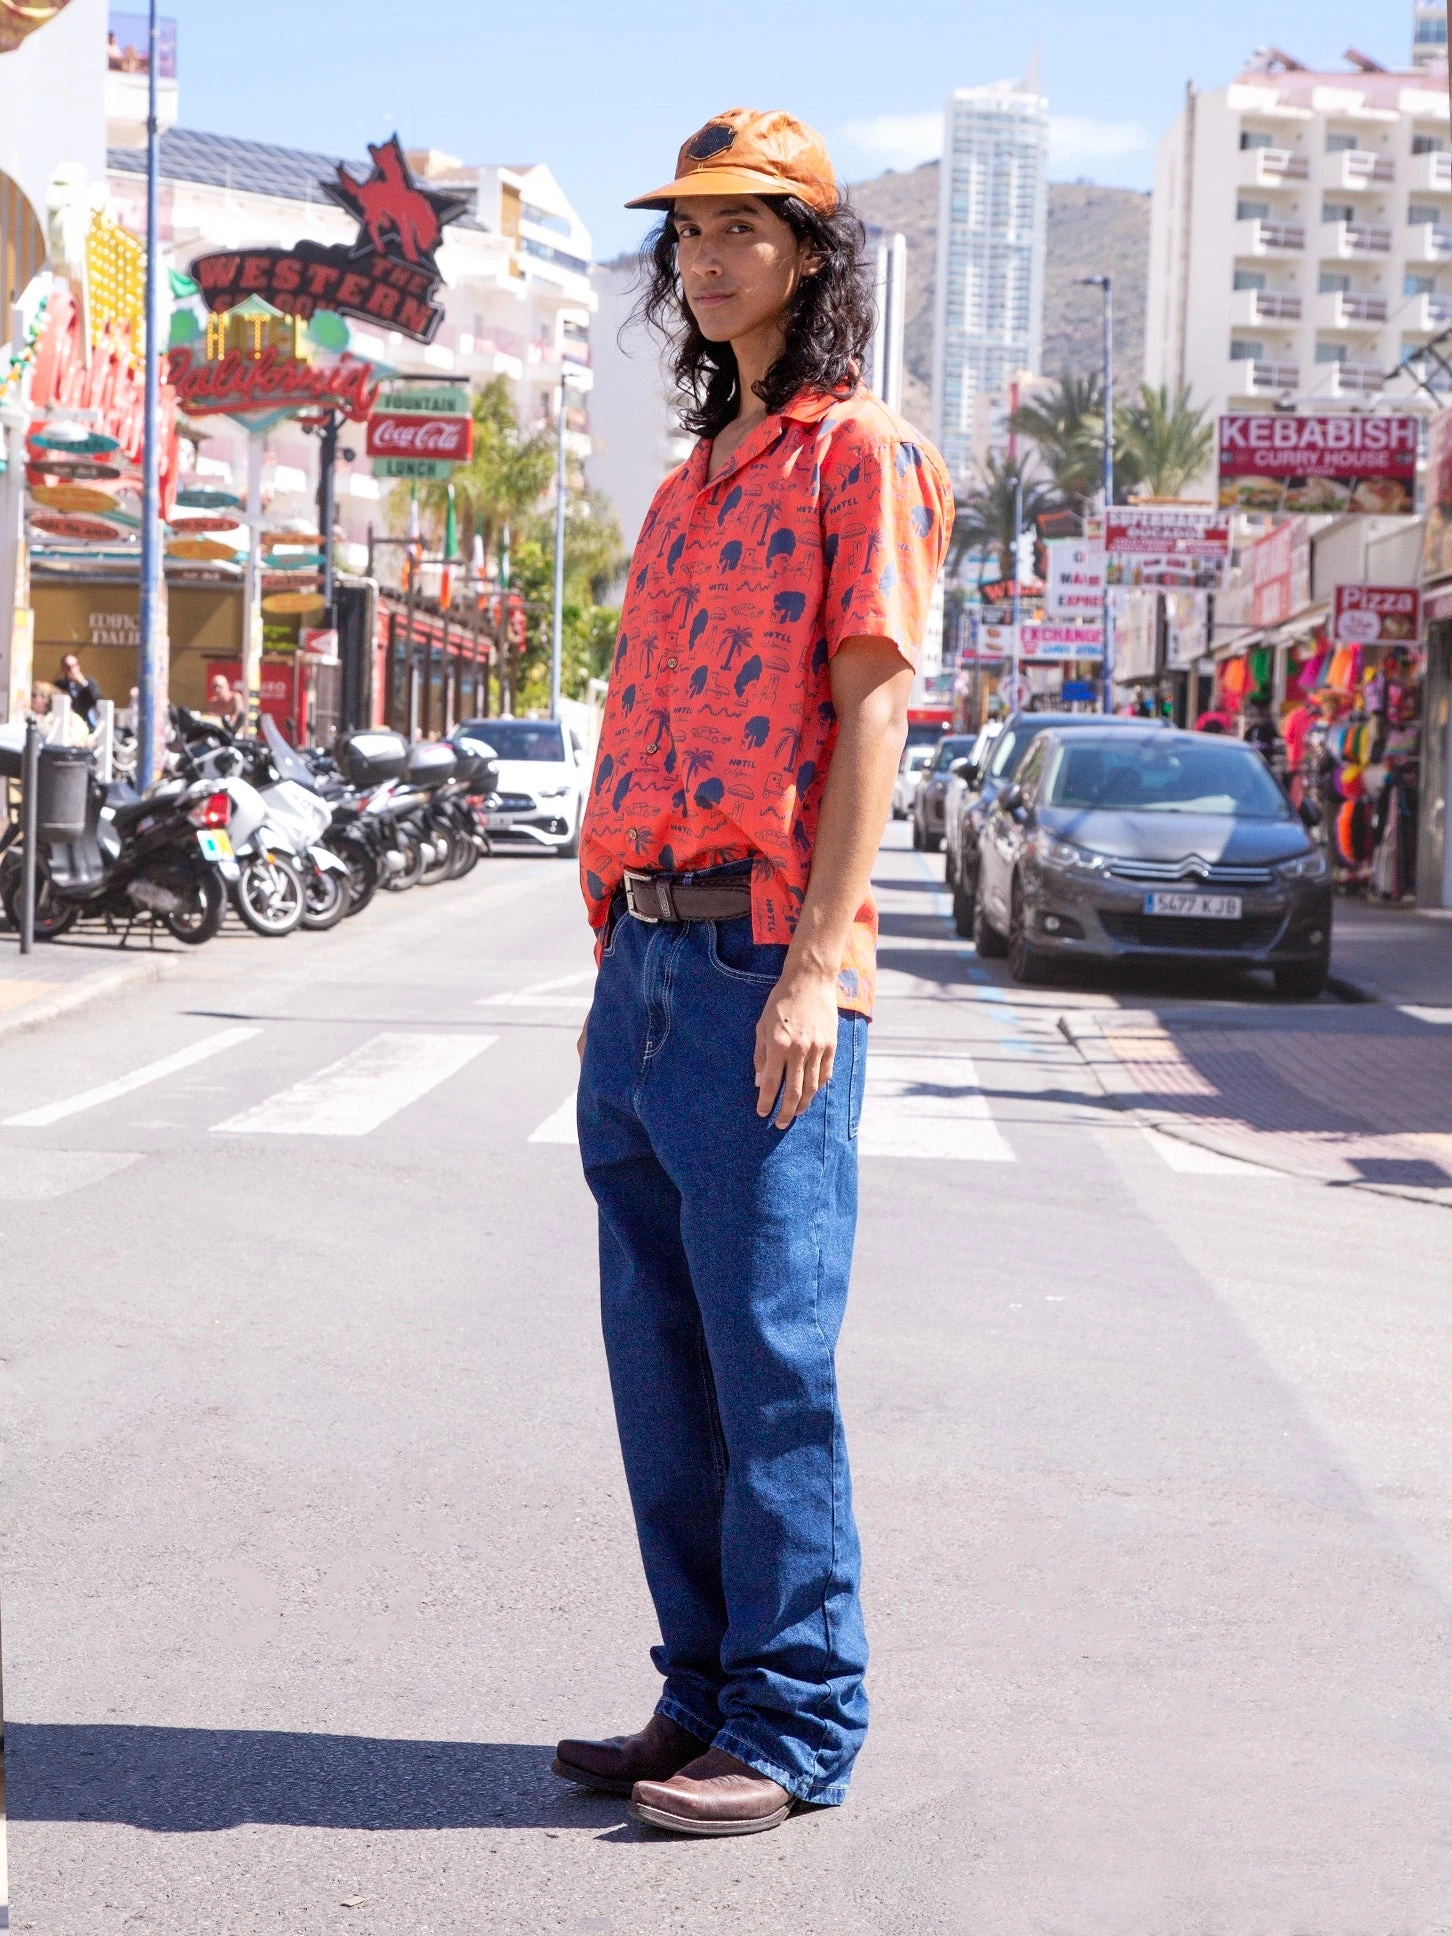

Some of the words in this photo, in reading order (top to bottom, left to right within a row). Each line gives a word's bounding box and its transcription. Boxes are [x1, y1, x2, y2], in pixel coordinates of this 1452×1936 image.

[372, 257, 431, 295] THE
[199, 256, 434, 332] WESTERN
[1220, 417, 1415, 449] KEBABISH
[386, 460, 437, 476] LUNCH
[1254, 450, 1319, 467] CURRY
[1324, 450, 1391, 468] HOUSE
[796, 506, 819, 515] HOTE
[829, 497, 859, 515] HOTEL
[708, 583, 729, 591] HOTEL
[1343, 587, 1413, 612] Pizza
[90, 612, 140, 630] EDIFIC
[763, 630, 792, 643] HOTEL
[673, 706, 692, 715] HOTEL
[729, 758, 756, 769] HOTEL
[670, 823, 692, 836] HOTEL
[766, 899, 776, 932] HOTEL
